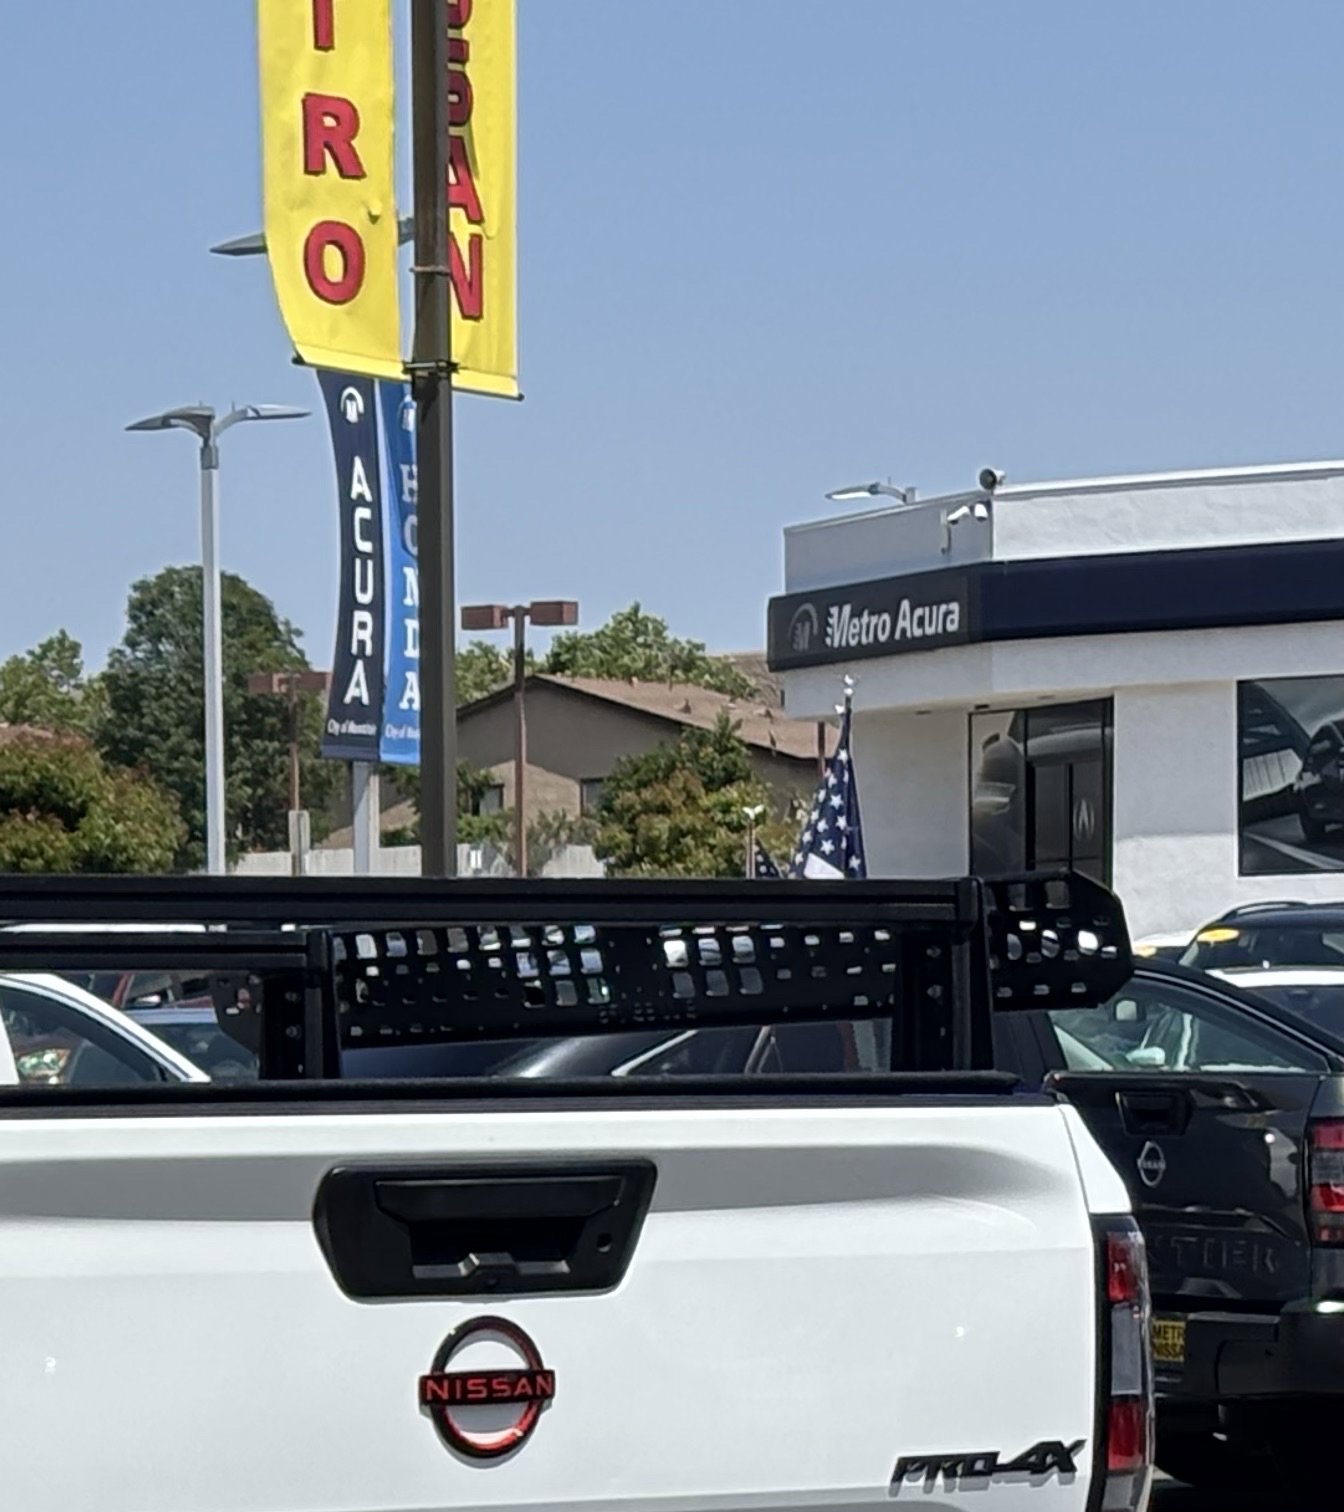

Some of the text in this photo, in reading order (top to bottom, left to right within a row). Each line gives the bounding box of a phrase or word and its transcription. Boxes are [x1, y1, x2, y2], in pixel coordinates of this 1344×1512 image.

[343, 456, 375, 706] ACURA
[825, 598, 960, 648] Metro Acura
[426, 1374, 552, 1400] NISSAN
